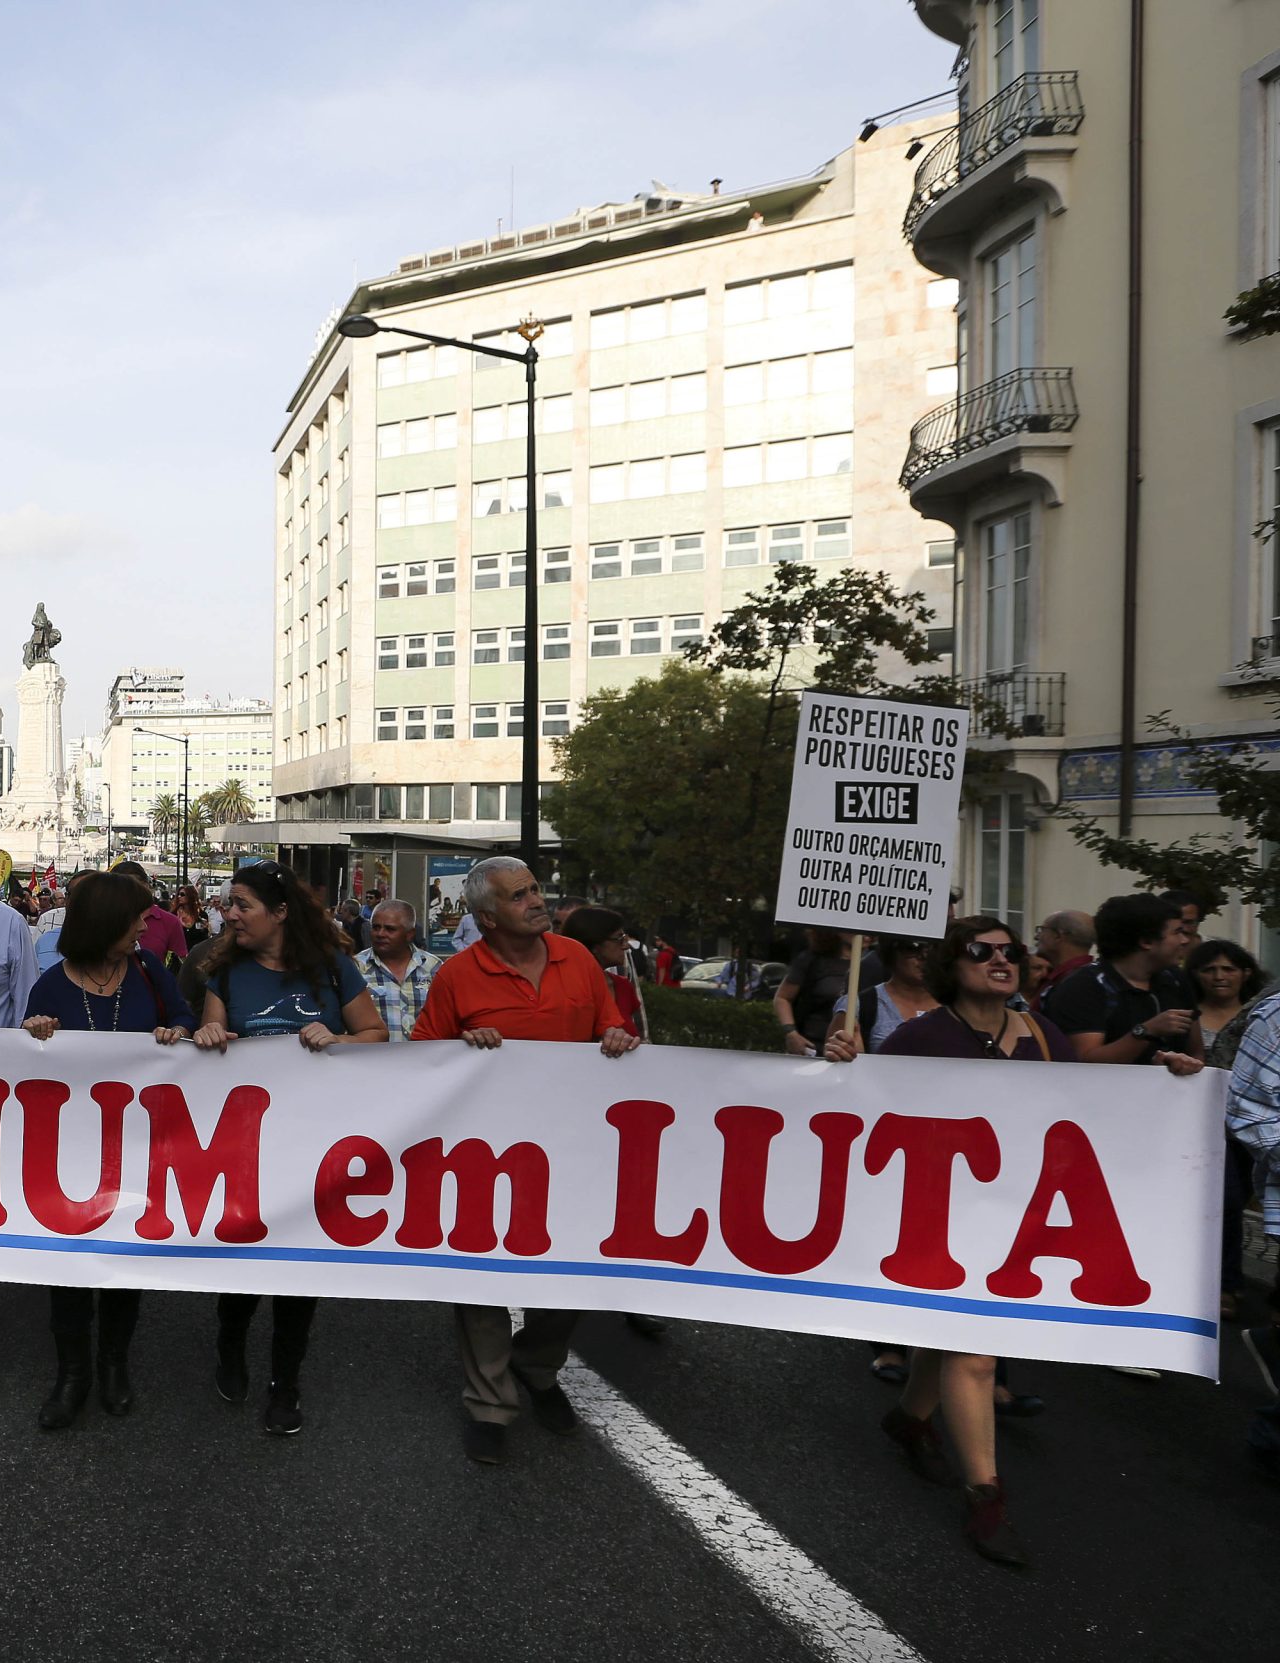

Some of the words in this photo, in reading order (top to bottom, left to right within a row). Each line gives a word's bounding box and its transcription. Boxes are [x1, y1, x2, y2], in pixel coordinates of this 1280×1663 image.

[808, 703, 924, 744] RESPEITAR
[931, 717, 960, 748] OS
[804, 736, 956, 781] PORTUGUESES
[843, 785, 911, 819] EXIGE
[792, 827, 845, 854] OUTRO
[848, 833, 946, 868] ORÇAMENTO,
[799, 857, 852, 884] OUTRA
[858, 863, 933, 895] POLÍTICA,
[797, 886, 852, 913] OUTRO
[856, 892, 929, 921] GOVERNO
[314, 1135, 551, 1257] em
[600, 1101, 1152, 1307] LUTA
